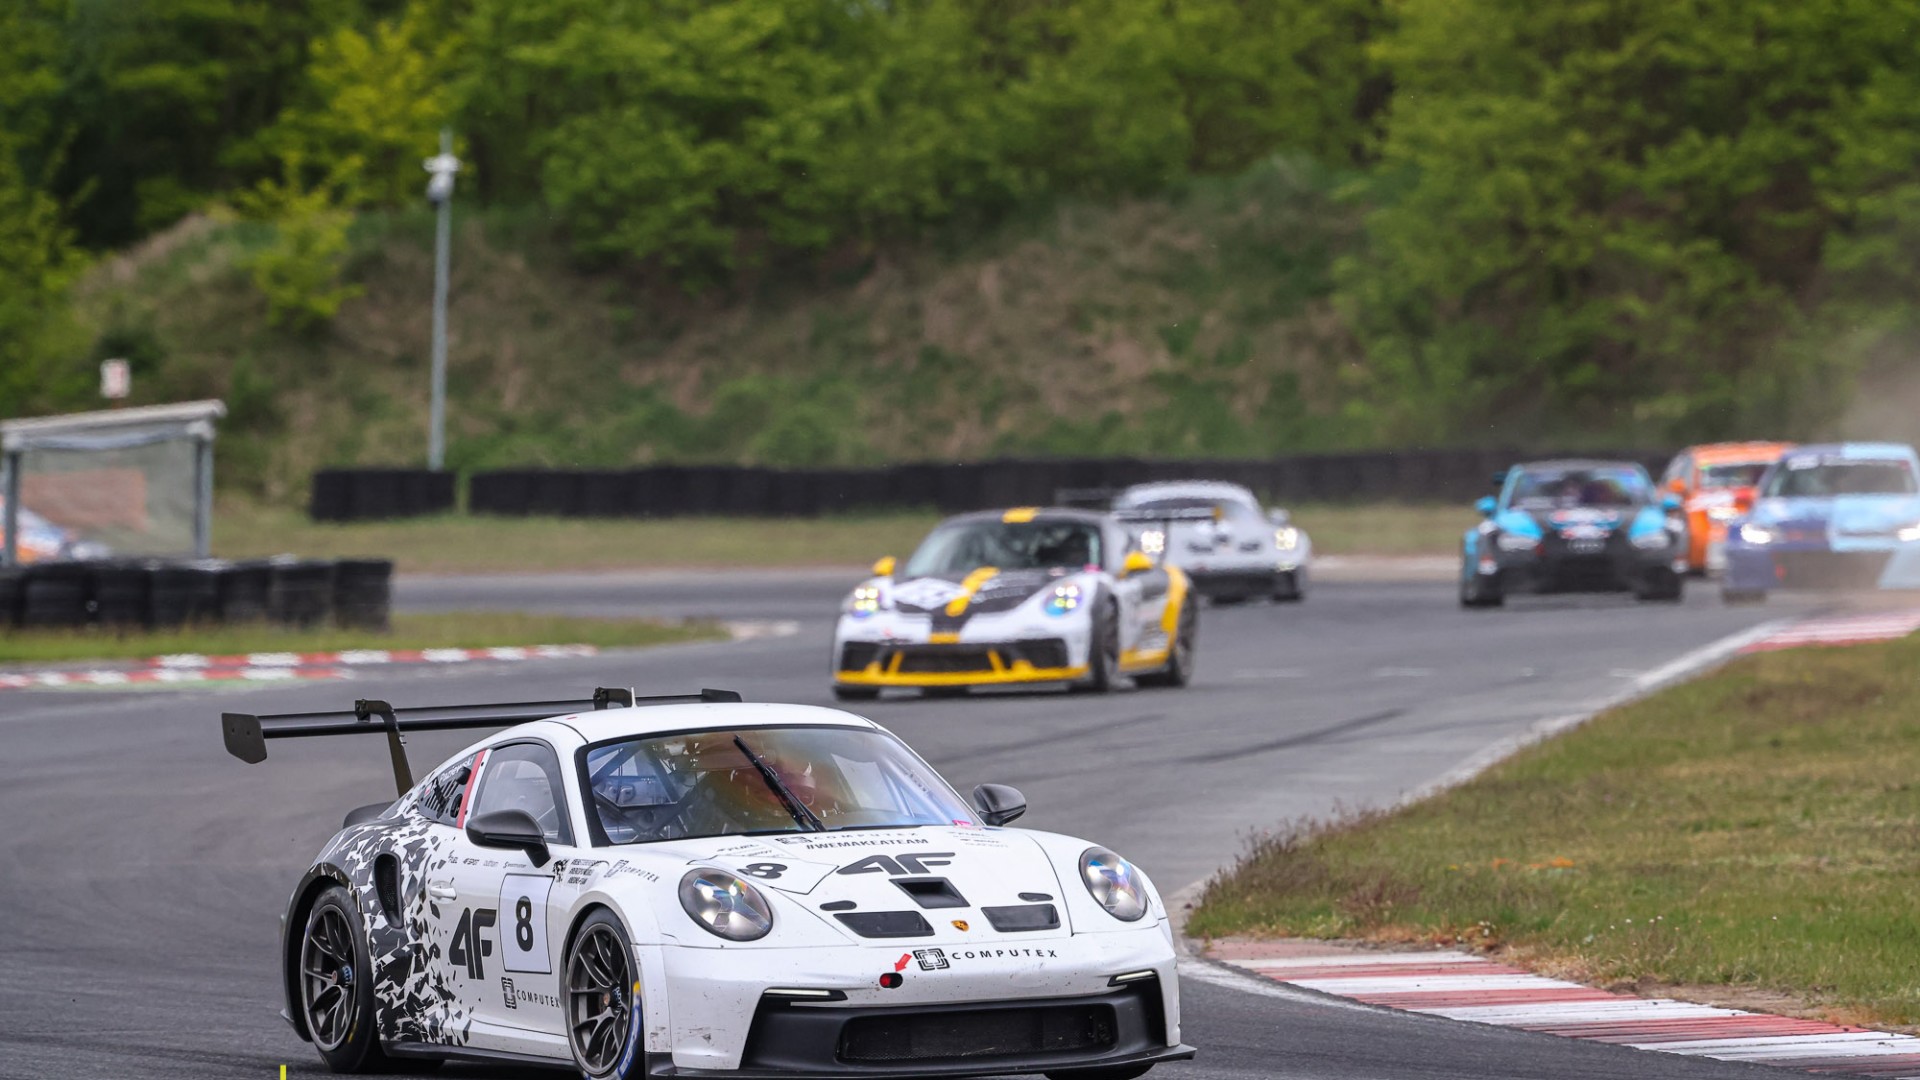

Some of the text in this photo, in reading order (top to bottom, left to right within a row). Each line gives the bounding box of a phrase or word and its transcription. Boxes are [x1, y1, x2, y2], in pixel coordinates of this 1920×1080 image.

[806, 838, 929, 850] #WEMAKEATEAM
[814, 832, 918, 840] COMPUTEX
[745, 862, 788, 879] 8
[836, 852, 956, 876] 4F
[621, 866, 660, 883] COMPUTEX
[516, 895, 534, 952] 8
[449, 907, 497, 980] 4F
[952, 949, 1057, 960] COMPUTEX
[516, 989, 560, 1008] COMPUTEX
